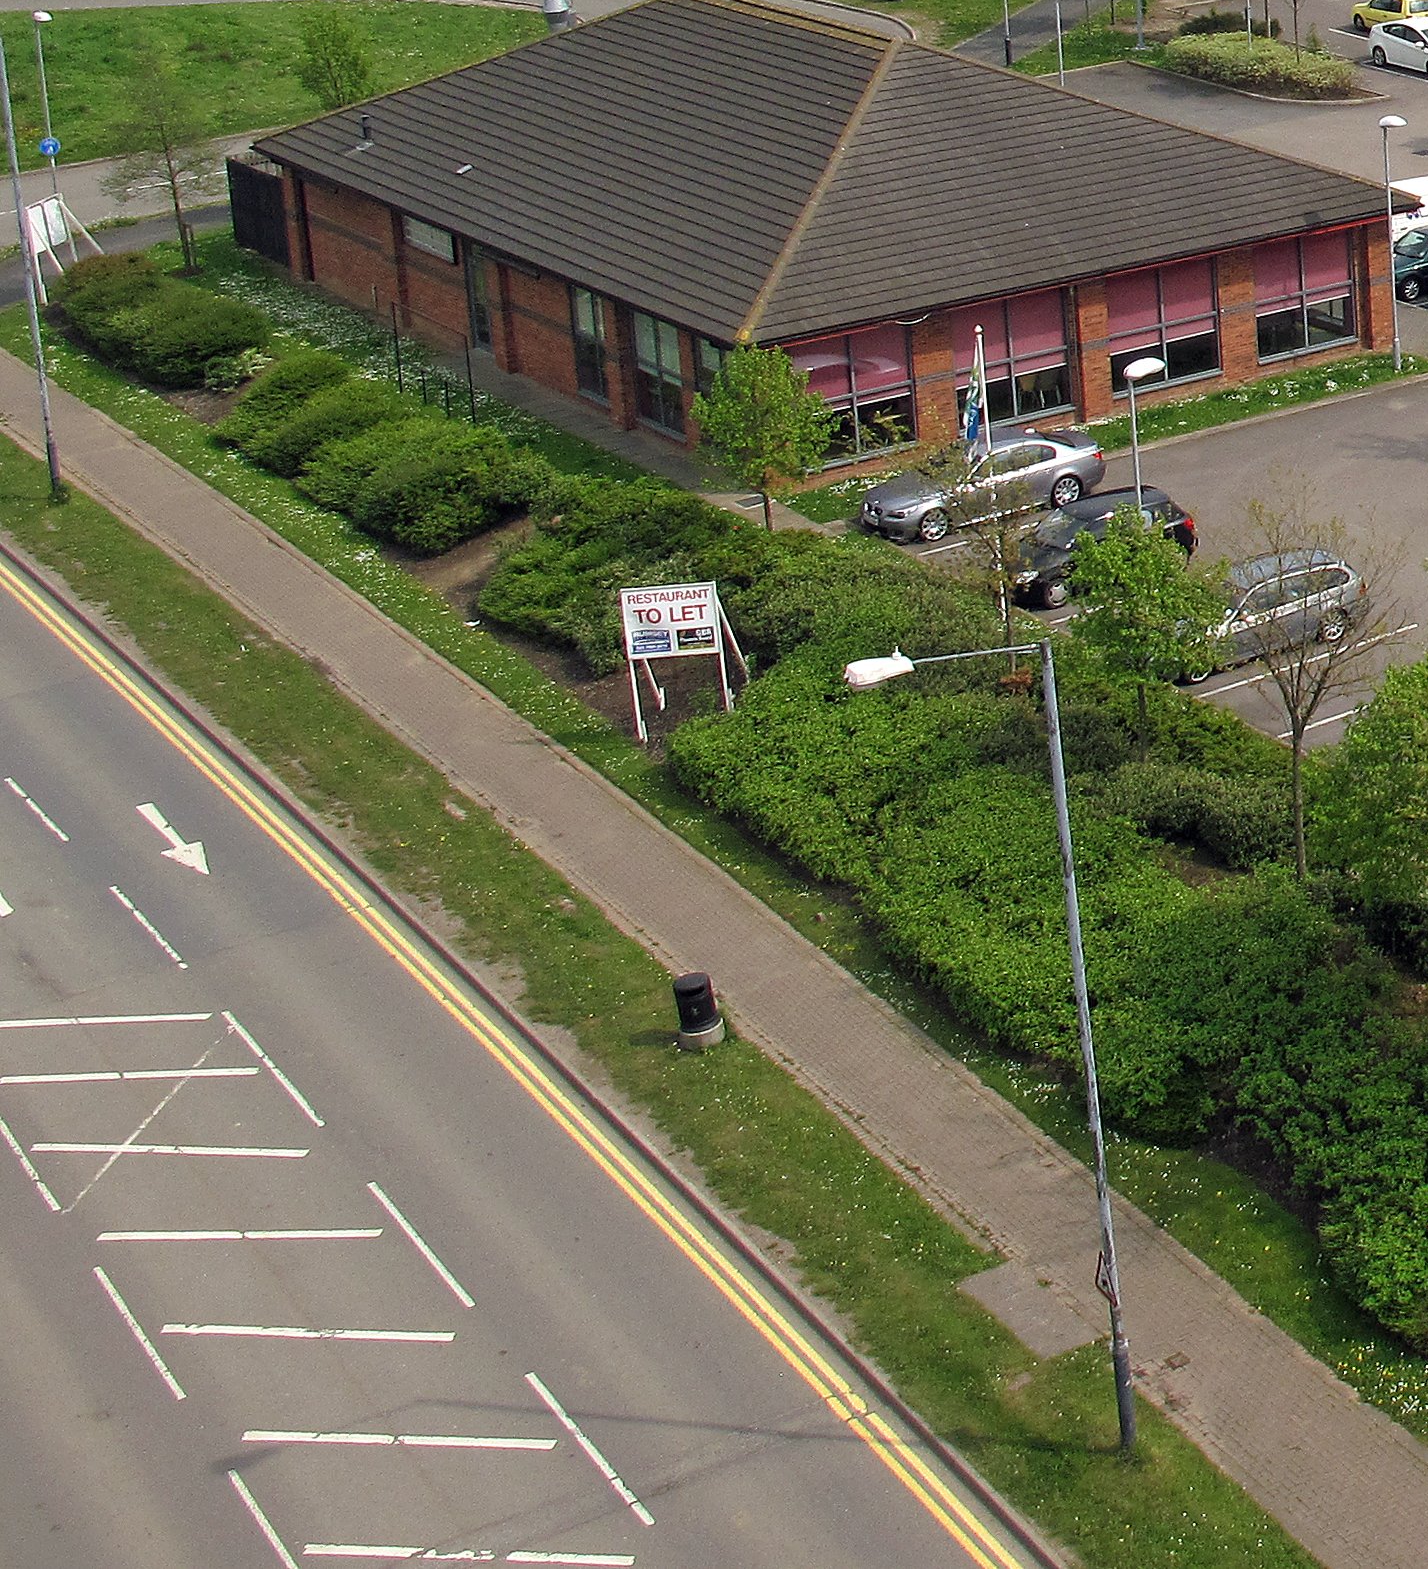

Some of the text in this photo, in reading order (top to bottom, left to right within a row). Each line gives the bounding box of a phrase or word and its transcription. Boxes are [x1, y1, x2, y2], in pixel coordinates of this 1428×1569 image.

[627, 589, 709, 604] RESTAURANT
[633, 604, 707, 624] TO LET
